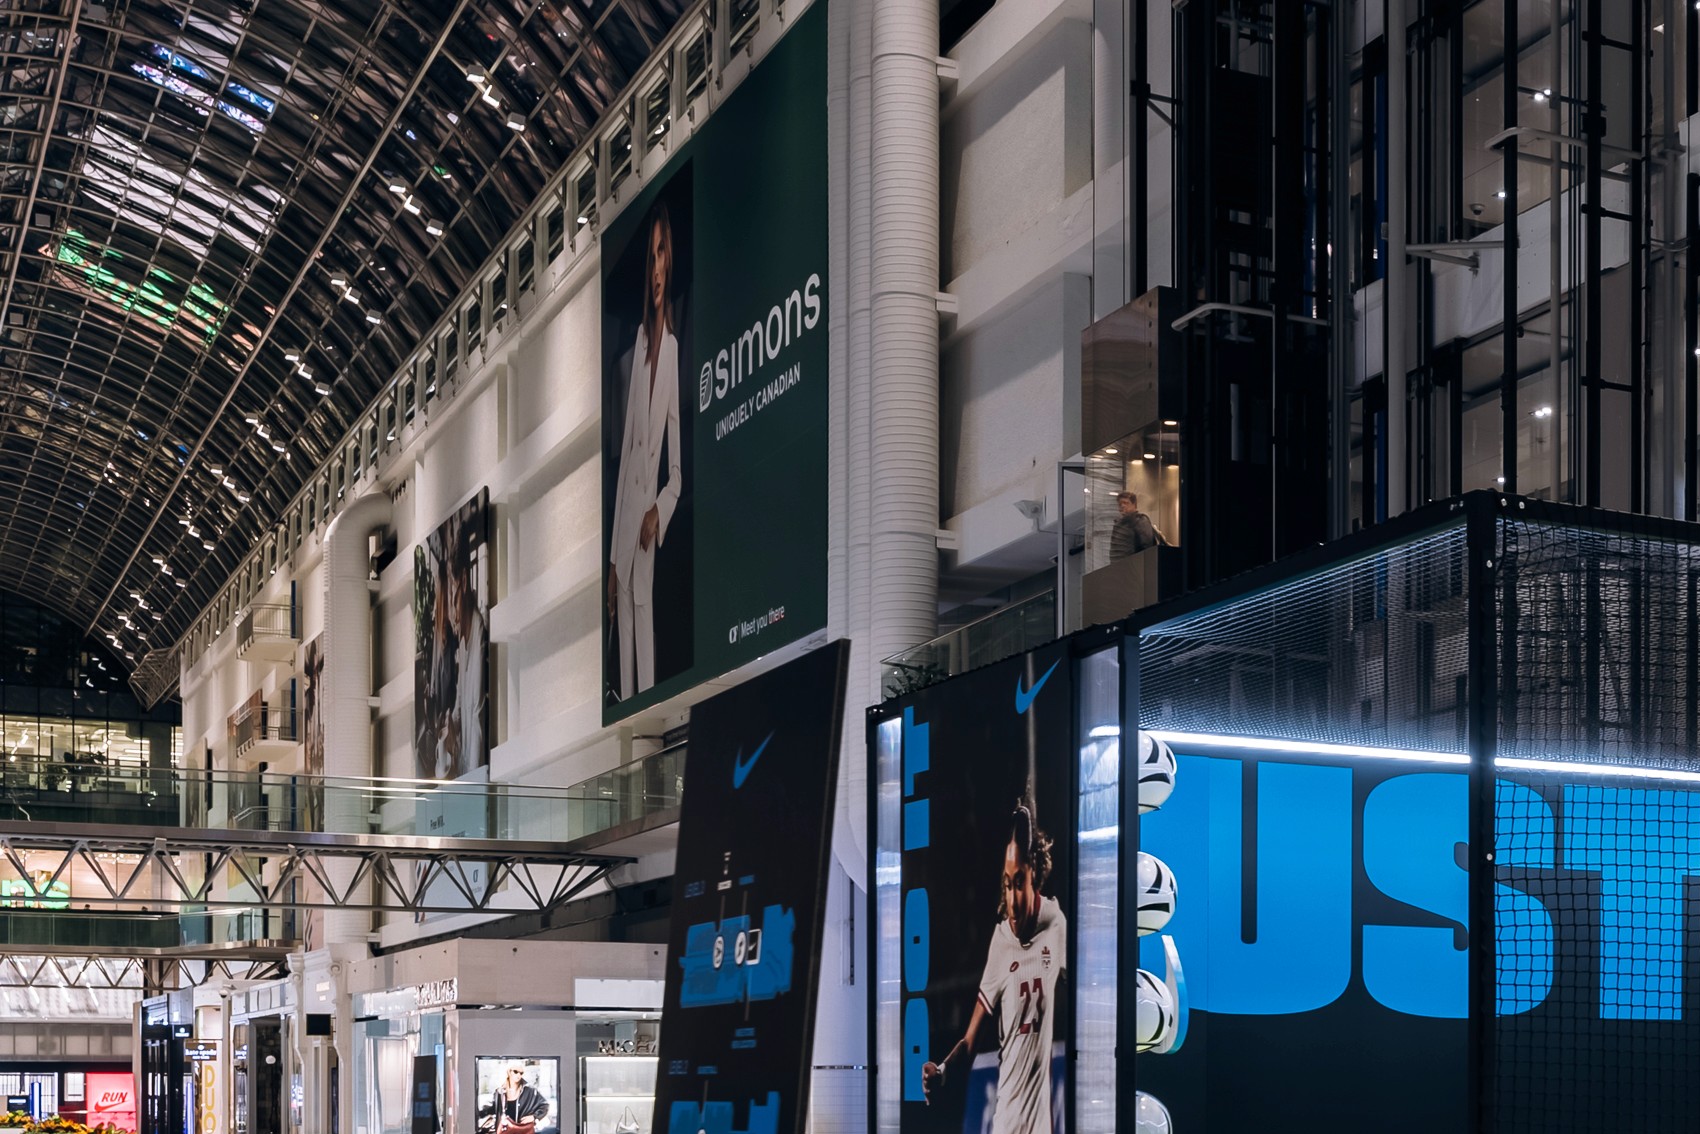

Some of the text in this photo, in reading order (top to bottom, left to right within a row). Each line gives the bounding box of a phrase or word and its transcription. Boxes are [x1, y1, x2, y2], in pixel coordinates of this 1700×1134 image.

[715, 273, 821, 400] simons
[715, 361, 800, 441] UNIQUELY CANADIAN
[741, 621, 755, 638] Meet
[756, 614, 768, 635] you
[768, 605, 785, 625] there
[904, 705, 930, 850] IT
[904, 888, 930, 1102] DO
[101, 1092, 128, 1103] RUN
